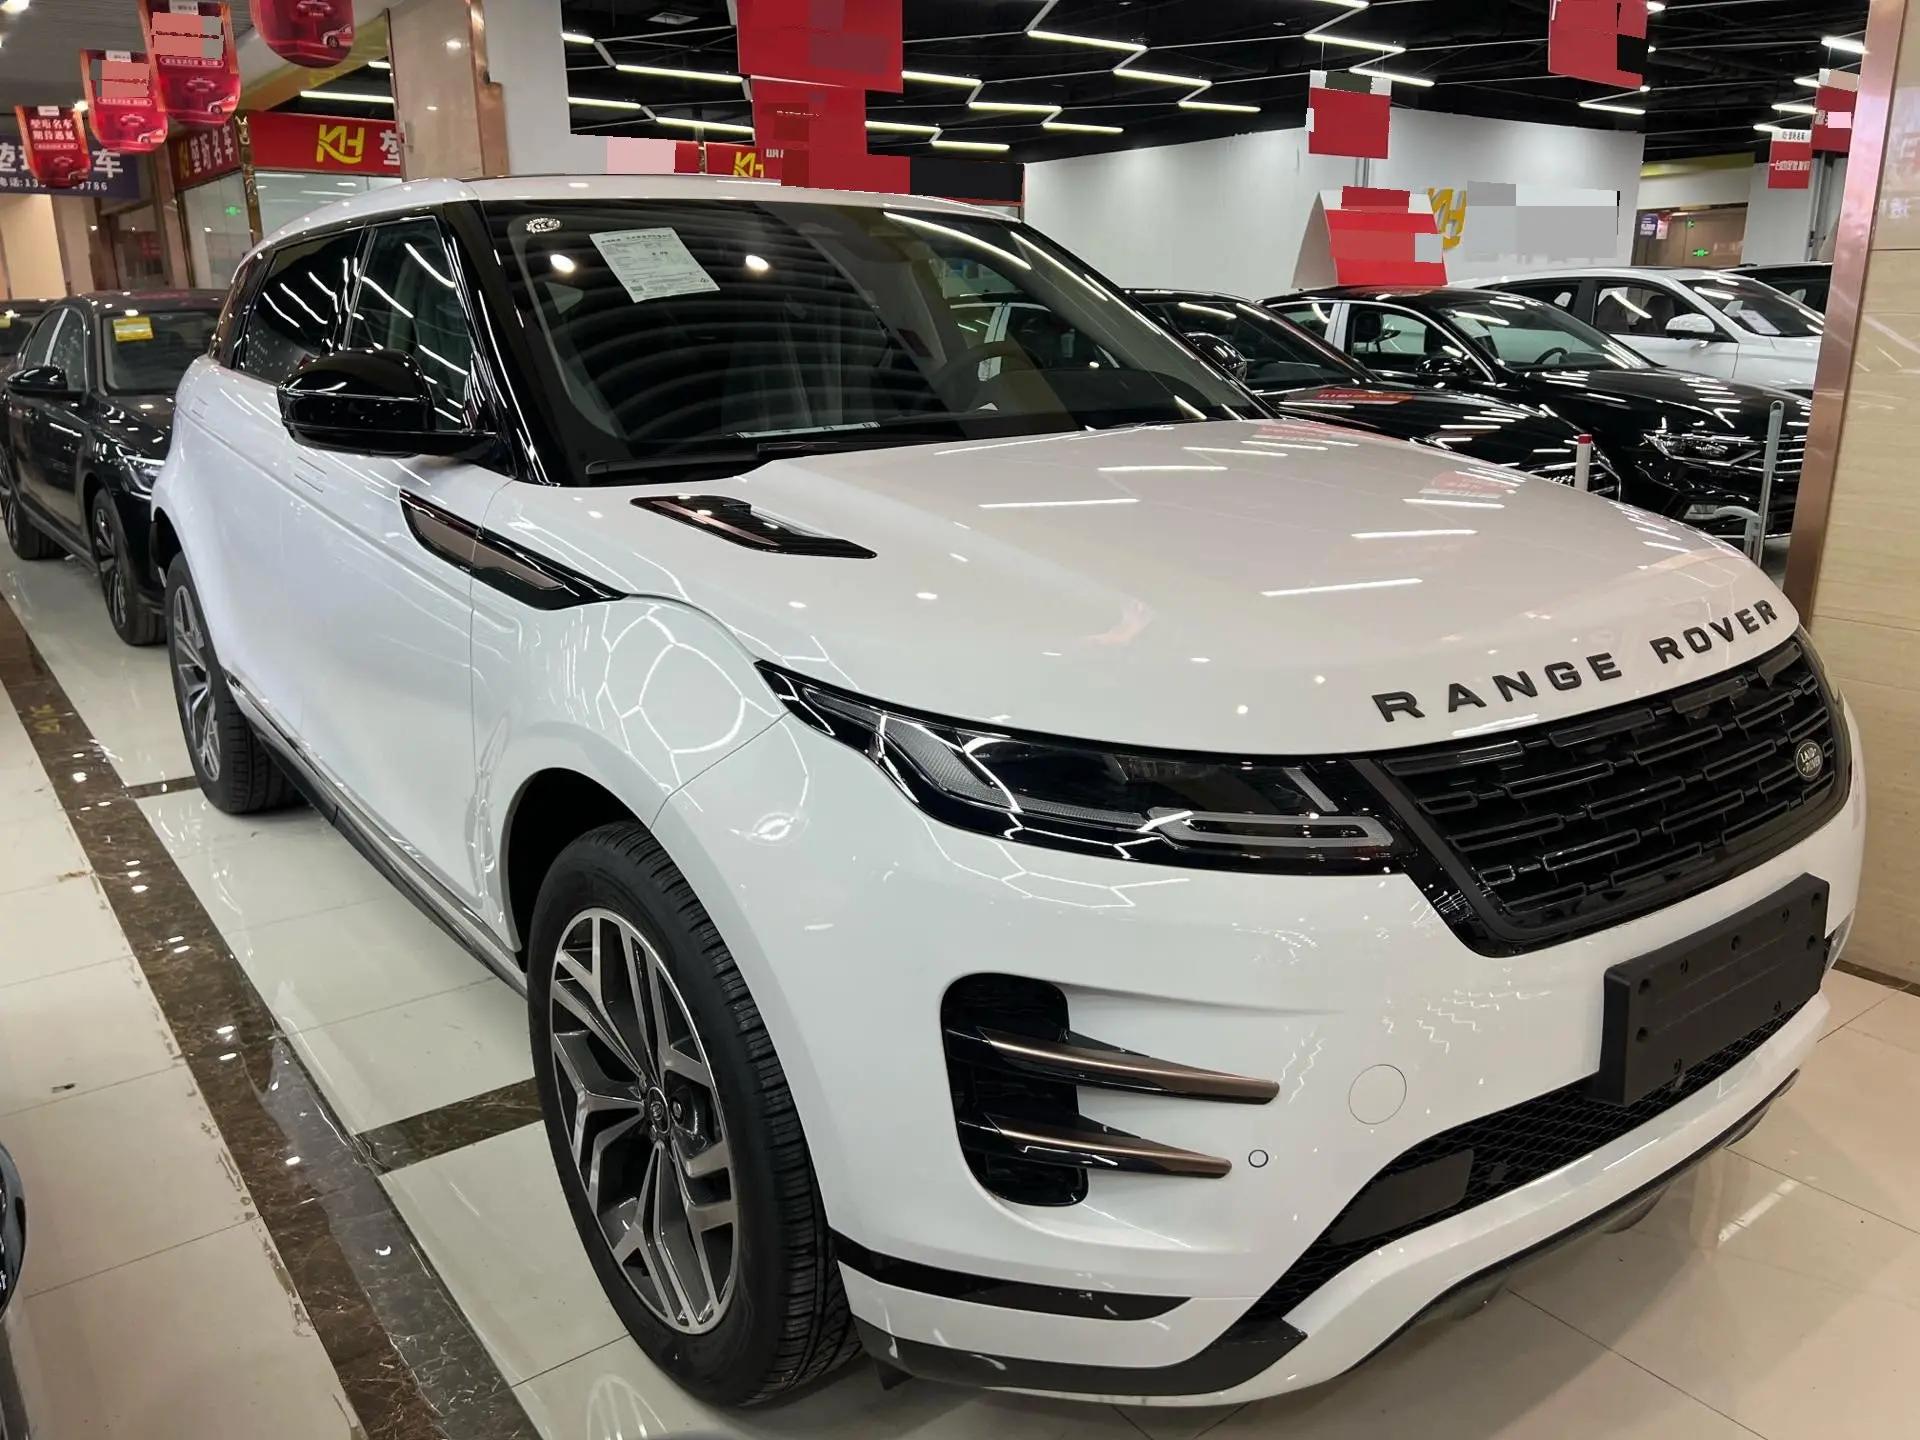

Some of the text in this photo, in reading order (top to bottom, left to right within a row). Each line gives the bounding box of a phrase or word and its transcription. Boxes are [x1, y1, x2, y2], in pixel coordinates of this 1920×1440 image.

[316, 124, 365, 164] KH
[1371, 599, 1778, 723] RANGE ROVER
